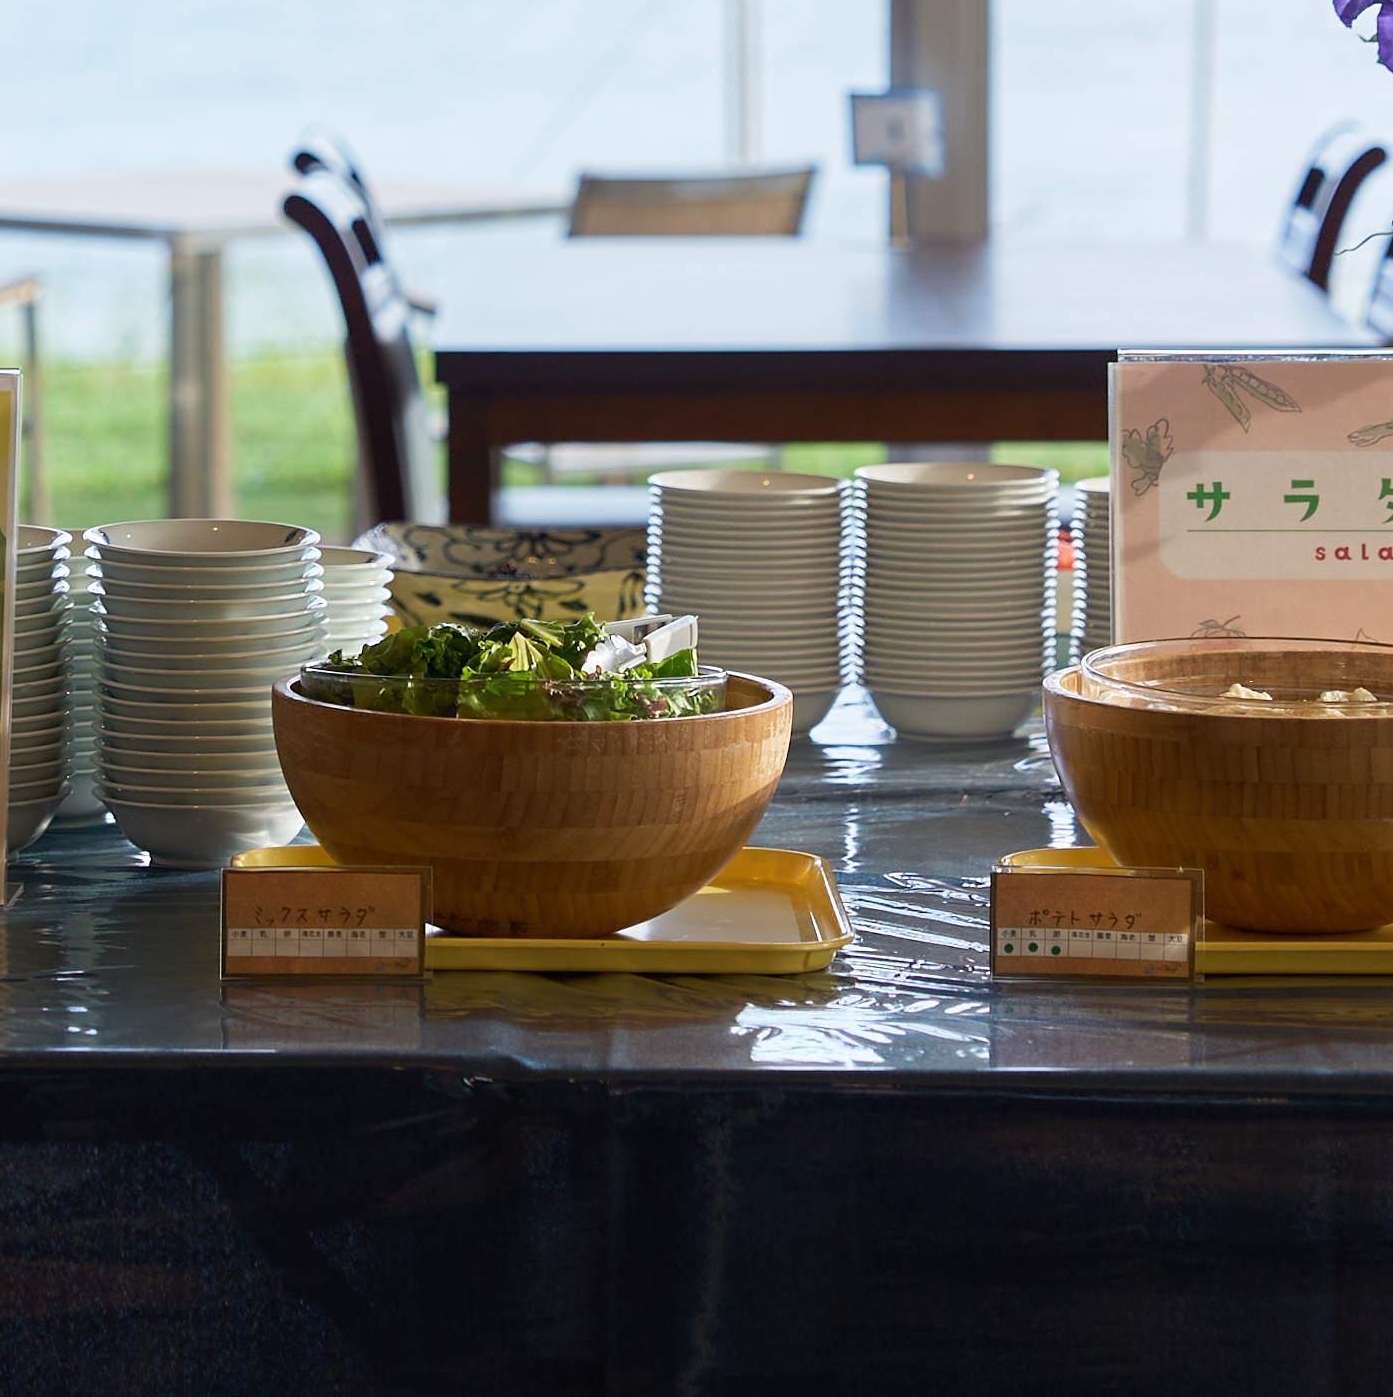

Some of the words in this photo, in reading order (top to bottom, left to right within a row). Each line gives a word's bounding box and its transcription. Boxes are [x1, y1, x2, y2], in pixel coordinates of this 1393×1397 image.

[1029, 909, 1141, 929] ポテトサラダ
